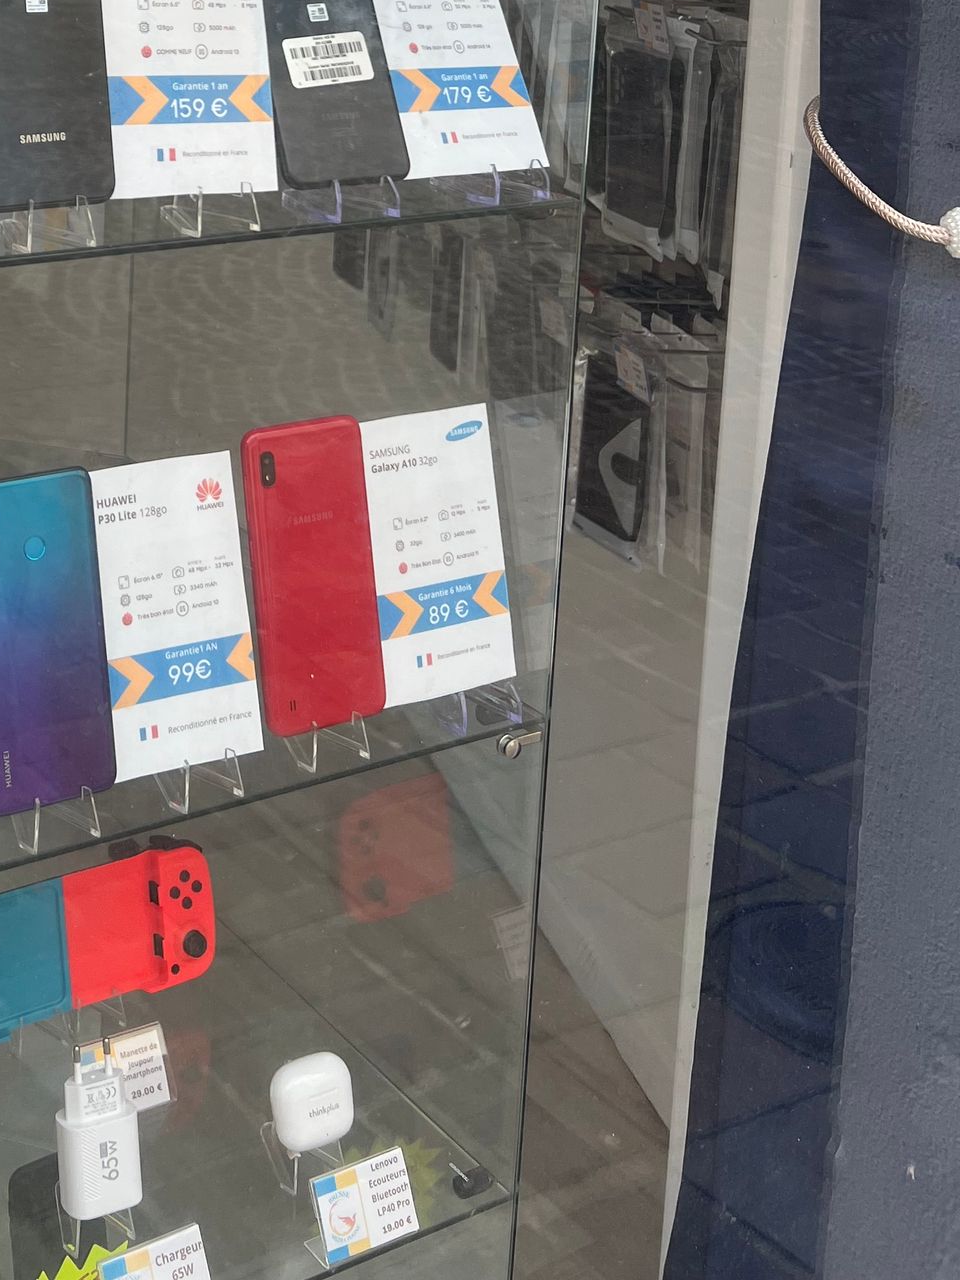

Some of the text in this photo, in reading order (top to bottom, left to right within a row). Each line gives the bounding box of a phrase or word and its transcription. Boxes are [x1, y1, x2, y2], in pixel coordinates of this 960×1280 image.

[172, 82, 208, 91] Garantie
[217, 82, 228, 91] an
[441, 73, 471, 82] Garantie
[479, 73, 488, 81] an
[442, 85, 491, 104] 179 €
[170, 97, 228, 118] 159 €
[19, 131, 67, 145] SAMSUNG
[369, 444, 411, 460] SAMSUNG
[371, 455, 438, 474] Galaxy A10 32go
[96, 493, 137, 509] HUAWEI
[196, 501, 224, 512] HUAWEI
[98, 505, 168, 525] P30 Lite 128go
[418, 588, 449, 602] Garantie
[456, 583, 472, 594] Mois
[429, 599, 469, 625] 89 €
[205, 641, 218, 652] AN
[168, 658, 212, 686] 99€
[5, 750, 13, 788] HUAWEI
[149, 1042, 158, 1051] de
[122, 1063, 163, 1081] Smartphone
[157, 1082, 164, 1092] €
[309, 1102, 340, 1118] thinkplus
[370, 1155, 398, 1172] Lenovo
[368, 1168, 407, 1188] Ecouteurs
[371, 1183, 410, 1203] Bluetooth
[377, 1198, 411, 1217] LP40 Pro
[406, 1216, 413, 1225] €
[155, 1239, 204, 1267] Chargeur
